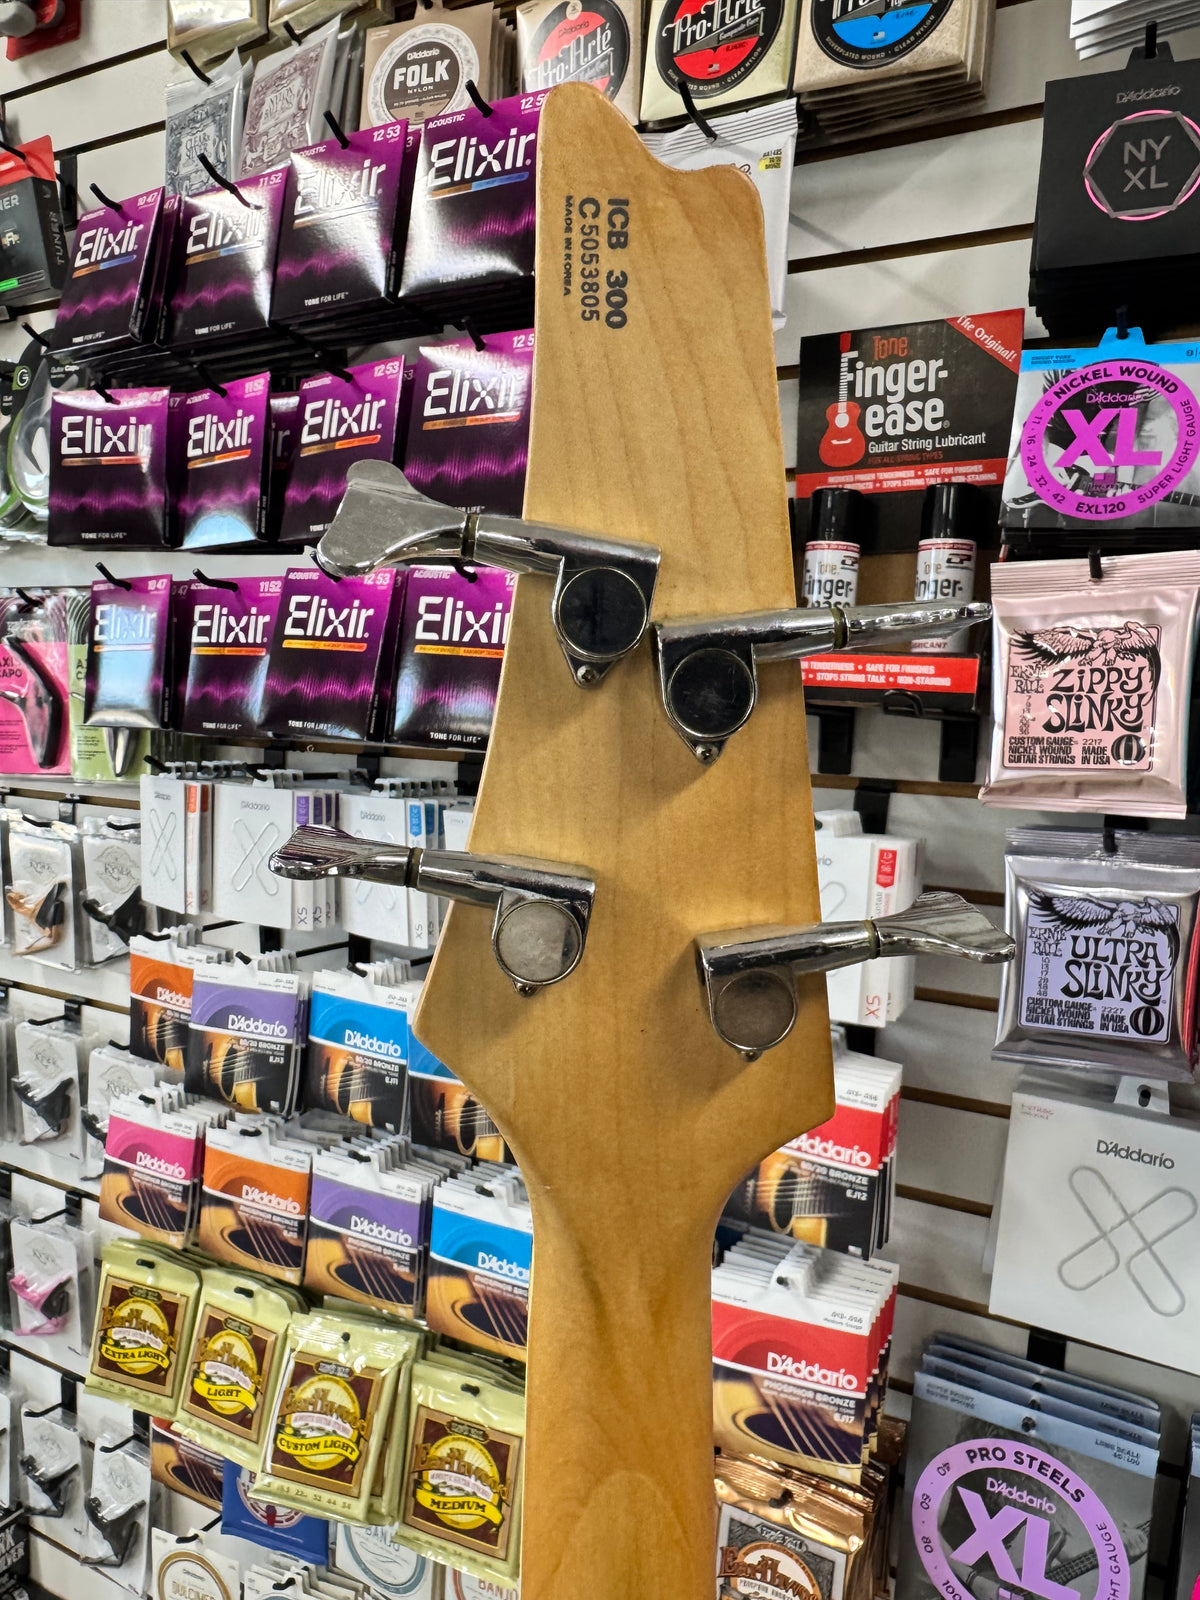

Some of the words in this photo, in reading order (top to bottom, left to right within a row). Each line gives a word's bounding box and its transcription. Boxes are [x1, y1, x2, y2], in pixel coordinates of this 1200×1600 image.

[393, 59, 450, 91] FOLK
[427, 114, 466, 130] ACOUSTIC
[428, 128, 536, 188] Elixir
[1123, 136, 1171, 165] NY
[293, 159, 387, 216] Elixir
[1122, 166, 1169, 194] XL
[564, 196, 574, 232] MADE
[607, 198, 630, 251] ICB
[74, 220, 144, 268] Elixir
[564, 237, 573, 251] IN
[578, 197, 601, 322] C5053805
[563, 255, 573, 297] KOREA
[605, 270, 628, 329] 300
[956, 315, 974, 333] The
[423, 369, 525, 418] Elixir
[1053, 366, 1114, 400] NICKEL
[1119, 365, 1180, 395] WOUND
[300, 393, 387, 445] Elixir
[1180, 398, 1197, 438] GAUGE
[60, 415, 153, 456] Elixir
[187, 409, 256, 458] Elixir
[868, 441, 899, 454] Guitar
[901, 436, 933, 451] String
[934, 431, 987, 448] Lubricant
[1026, 434, 1036, 446] 16
[1053, 407, 1164, 468] XL
[1027, 456, 1038, 468] 24
[1172, 440, 1195, 474] LIGHT
[1035, 476, 1049, 489] 32
[1137, 474, 1176, 505] SUPER
[1051, 492, 1067, 505] 42
[1075, 501, 1126, 516] EXL120
[376, 573, 391, 585] 53
[191, 603, 272, 645] Elixir
[284, 595, 375, 639] Elixir
[430, 732, 447, 740] TONE
[449, 734, 462, 742] FOR
[463, 735, 478, 743] LIFE
[1040, 746, 1072, 755] WOUND
[1082, 746, 1108, 756] MADE
[1038, 755, 1076, 765] STRINGS
[1092, 756, 1111, 765] USA
[1070, 934, 1166, 970] ULTRA
[157, 985, 192, 1008] D'Addar
[865, 995, 881, 1019] XS
[227, 1013, 289, 1038] D'Addario
[344, 1029, 402, 1057] D'Addario
[136, 1151, 187, 1180] D'Addario
[1096, 1138, 1176, 1170] D'Addario
[828, 1169, 869, 1186] BRONZE
[242, 1184, 301, 1215] D'Addario
[350, 1214, 413, 1247] D'Addario
[105, 1347, 136, 1361] EXTRA
[137, 1349, 167, 1365] LIGHT
[766, 1350, 858, 1391] D'Addario
[206, 1386, 242, 1399] LIGHT
[763, 1379, 814, 1400] PHOSPHOR
[815, 1392, 857, 1409] BRONZE
[279, 1437, 321, 1453] CUSTOM
[323, 1439, 356, 1456] LIGHT
[965, 1446, 1007, 1464] PRO
[1013, 1450, 1086, 1503] STEELS
[429, 1497, 487, 1514] MEDIUM
[986, 1476, 1057, 1515] D'Addario
[950, 1485, 1082, 1600] XL
[1096, 1522, 1122, 1576] GAUGE
[941, 1579, 962, 1600] 100
